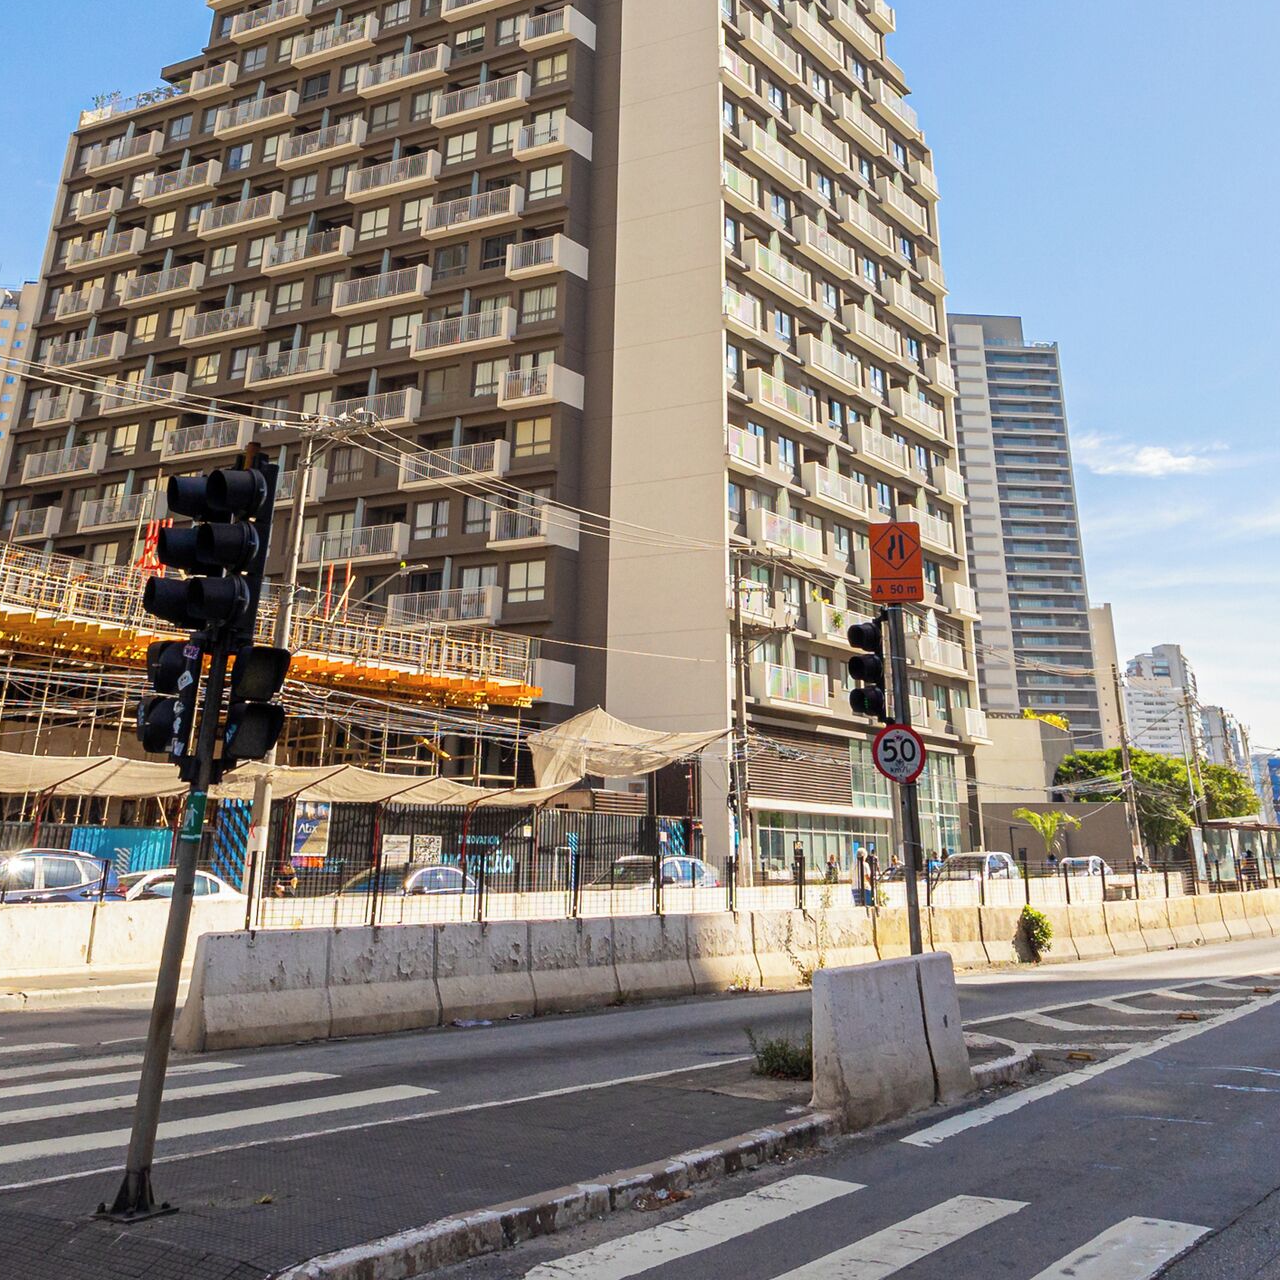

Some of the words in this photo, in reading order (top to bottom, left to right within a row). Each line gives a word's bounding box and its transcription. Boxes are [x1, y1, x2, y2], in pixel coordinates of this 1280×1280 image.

[875, 584, 884, 594] A
[890, 584, 904, 594] 50
[906, 586, 917, 594] m
[882, 738, 916, 762] 50
